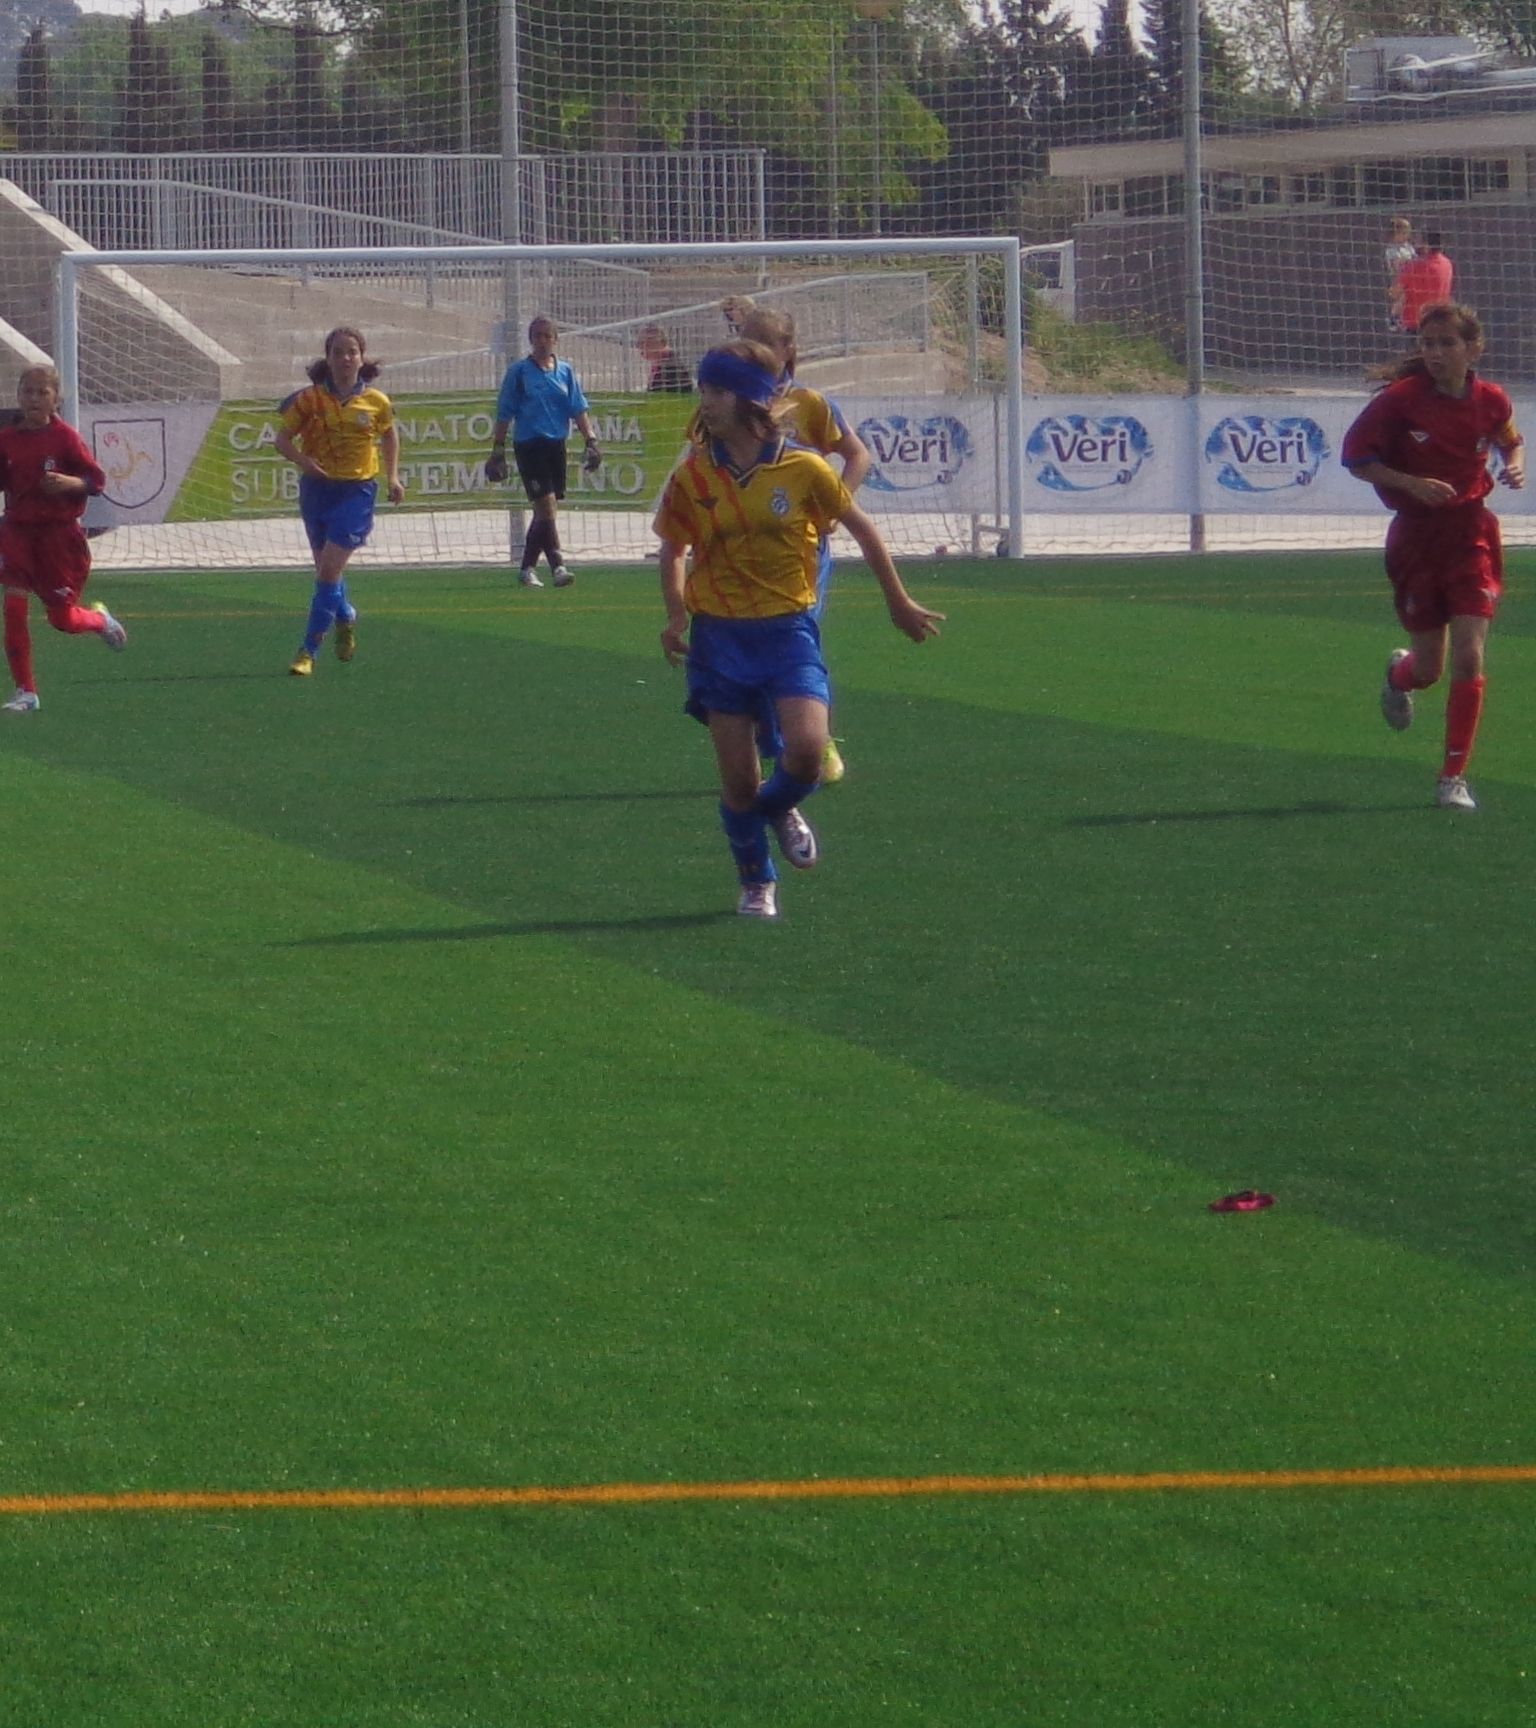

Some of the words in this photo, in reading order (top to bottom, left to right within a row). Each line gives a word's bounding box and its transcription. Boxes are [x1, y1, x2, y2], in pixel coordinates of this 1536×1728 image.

[872, 429, 949, 463] Veri
[1050, 431, 1128, 463] Veri
[1229, 430, 1307, 463] Veri
